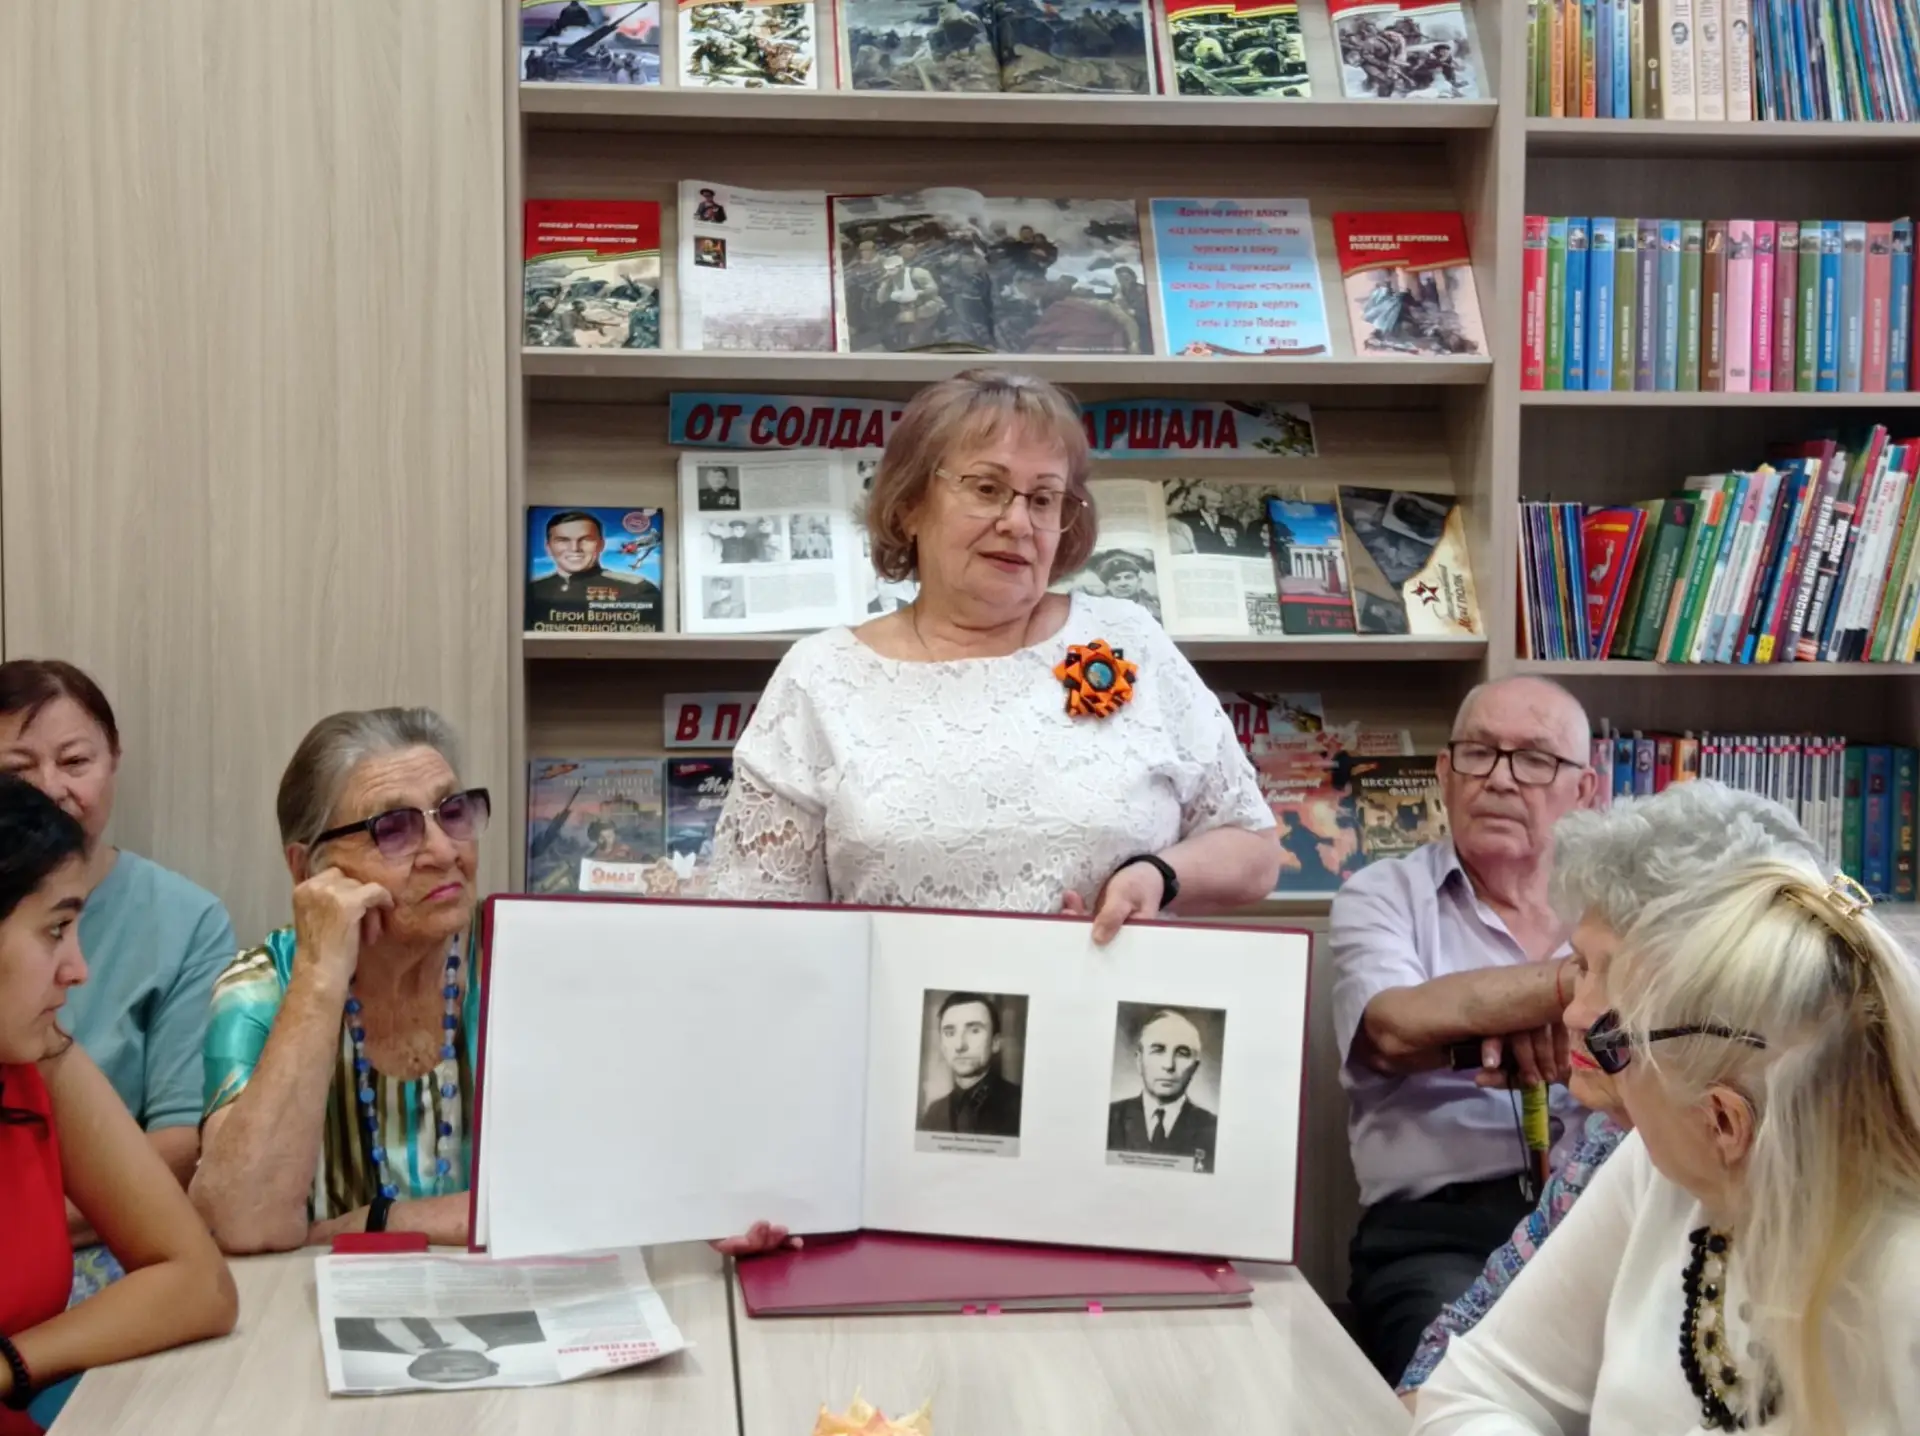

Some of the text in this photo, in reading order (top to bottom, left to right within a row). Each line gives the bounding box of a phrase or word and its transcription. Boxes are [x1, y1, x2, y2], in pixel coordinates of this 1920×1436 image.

[685, 403, 903, 449] ОТ СОЛДА
[1082, 408, 1239, 450] АРШАЛА
[675, 703, 702, 741] В
[1360, 777, 1437, 788] БЕССМЕРТН
